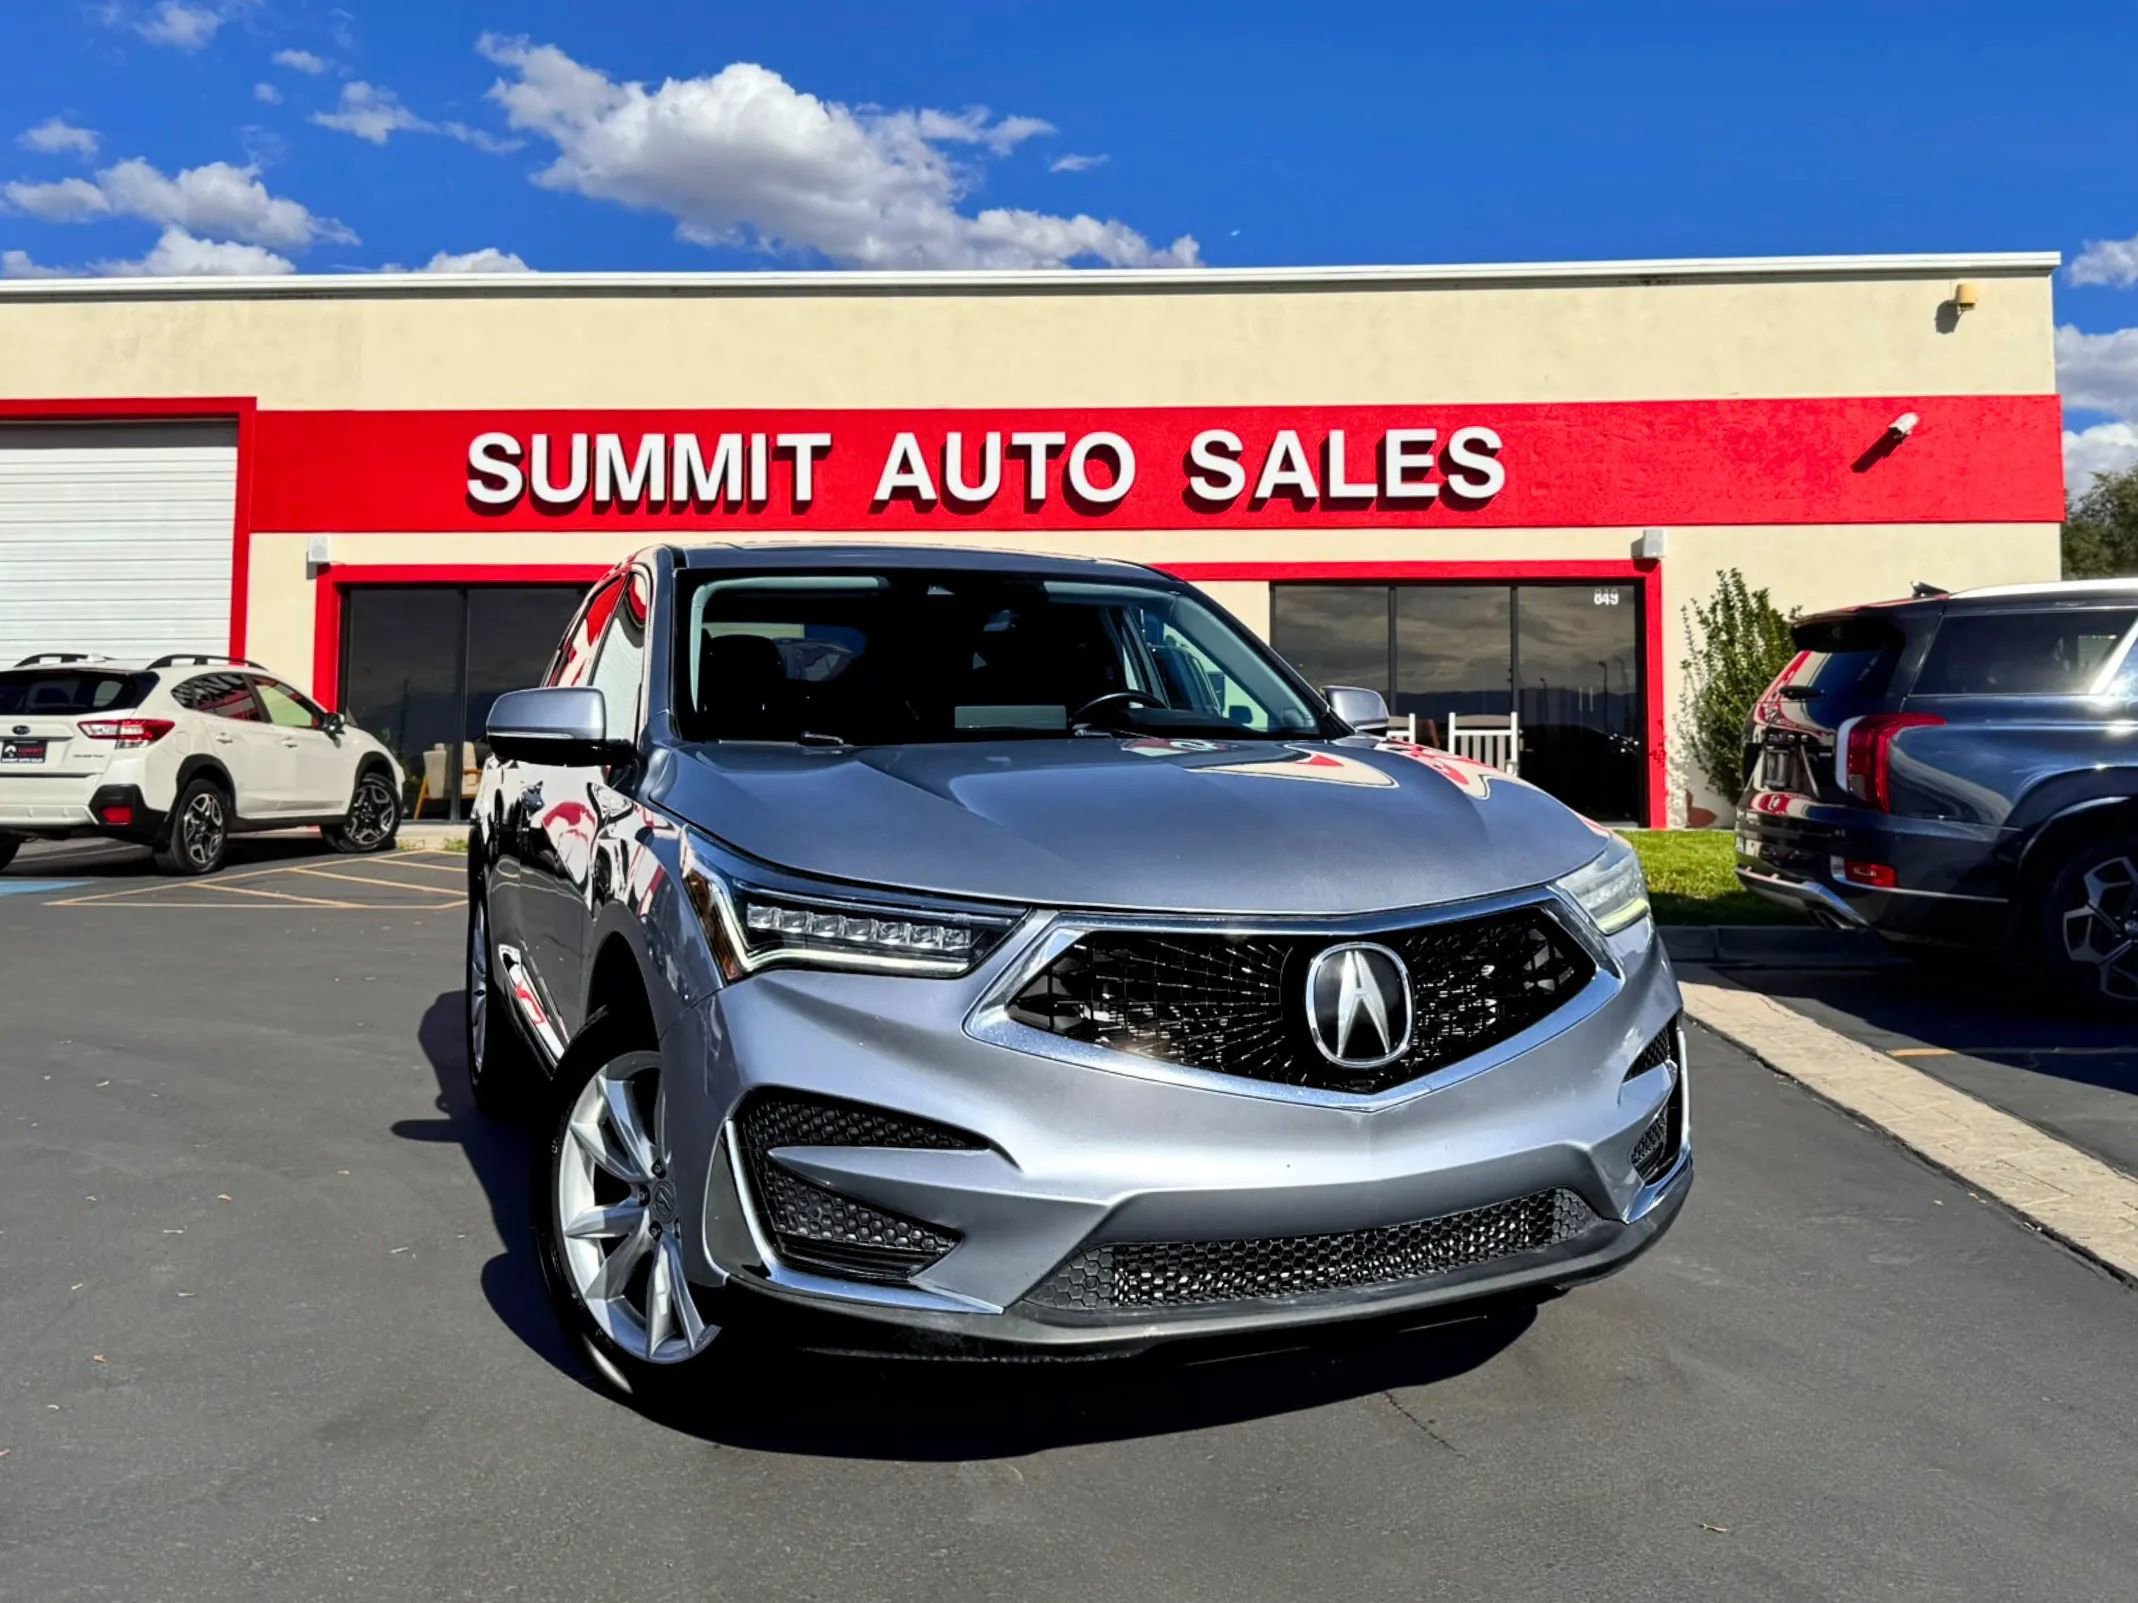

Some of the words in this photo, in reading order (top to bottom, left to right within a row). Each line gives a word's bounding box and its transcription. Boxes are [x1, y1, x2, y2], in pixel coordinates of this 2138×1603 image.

[467, 432, 831, 504] SUMMIT
[874, 432, 1136, 503] AUTO
[1190, 426, 1505, 501] SALES
